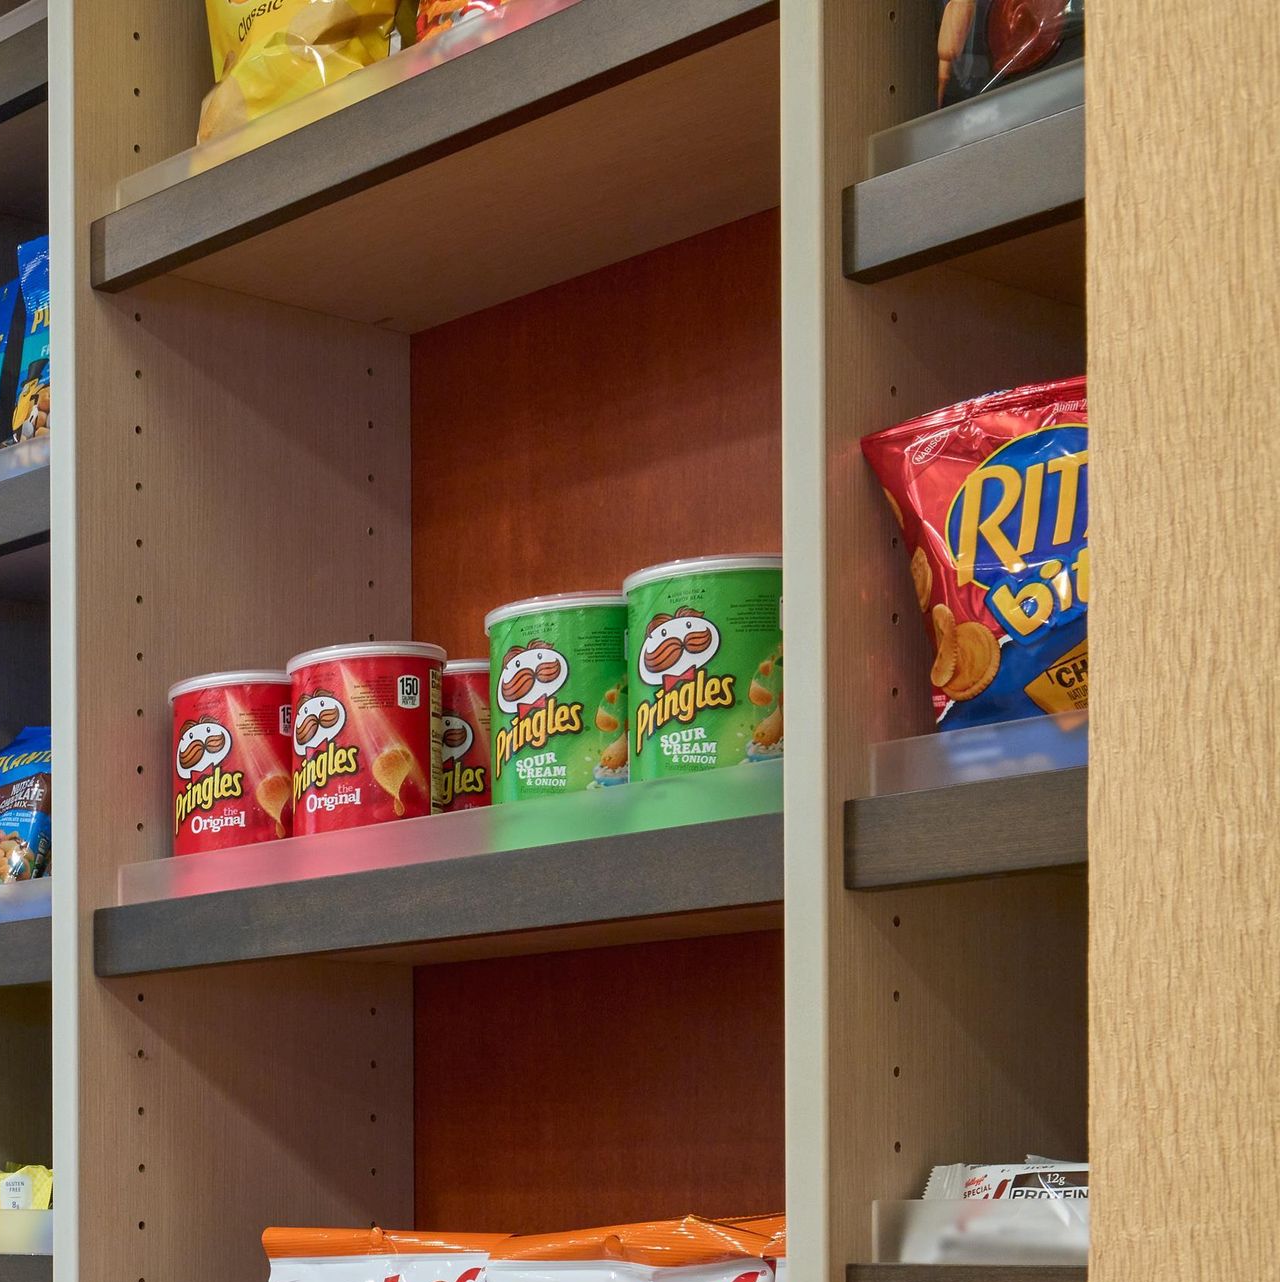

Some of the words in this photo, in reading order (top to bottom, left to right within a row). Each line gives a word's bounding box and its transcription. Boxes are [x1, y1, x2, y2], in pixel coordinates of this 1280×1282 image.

[238, 0, 283, 42] Classic
[915, 430, 949, 463] NABISCO
[957, 450, 1088, 588] RIT
[992, 555, 1088, 636] bit
[400, 677, 419, 696] 150
[281, 706, 292, 724] 15
[637, 669, 734, 754] Pringles
[496, 698, 582, 779] Pringles
[660, 727, 707, 745] SOUR
[662, 741, 717, 756] CREAM
[516, 752, 557, 770] SOUR
[672, 755, 679, 763] &
[681, 755, 717, 765] ONION
[293, 742, 358, 815] Pringles
[517, 765, 567, 780] CREAM
[337, 784, 354, 794] the
[527, 778, 533, 787] &
[534, 778, 567, 787] ONION
[176, 767, 243, 835] Pringles
[306, 788, 361, 813] Original
[223, 807, 239, 817] the
[191, 811, 246, 834] Original
[1046, 1173, 1066, 1186] 12g
[963, 1183, 992, 1199] SPECIAL
